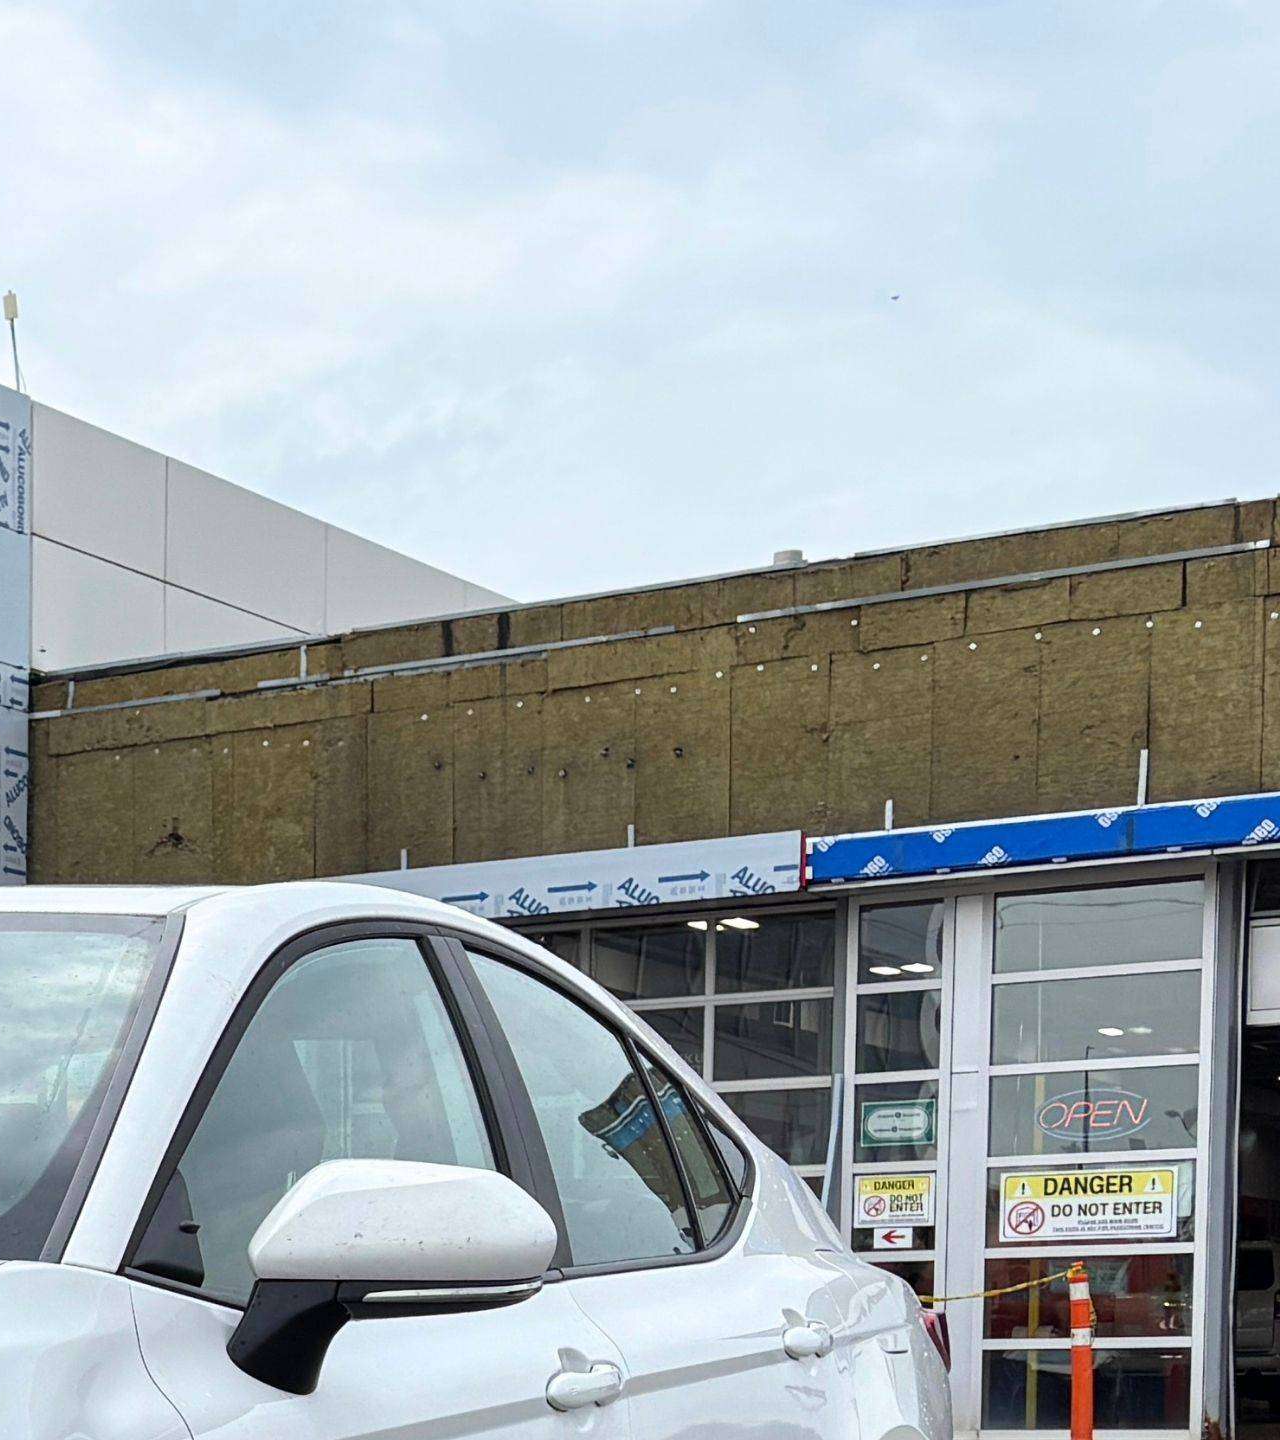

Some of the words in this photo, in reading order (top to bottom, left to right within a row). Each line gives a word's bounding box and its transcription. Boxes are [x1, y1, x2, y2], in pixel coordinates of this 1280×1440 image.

[1039, 1098, 1148, 1128] OPEN
[874, 1180, 915, 1190] DANGER
[1043, 1175, 1133, 1196] DANGER
[889, 1195, 903, 1203] DO
[905, 1193, 923, 1202] NOT
[889, 1202, 923, 1212] ENTER
[1051, 1204, 1073, 1217] DO
[1077, 1202, 1109, 1217] NOT
[1113, 1201, 1163, 1215] ENTER
